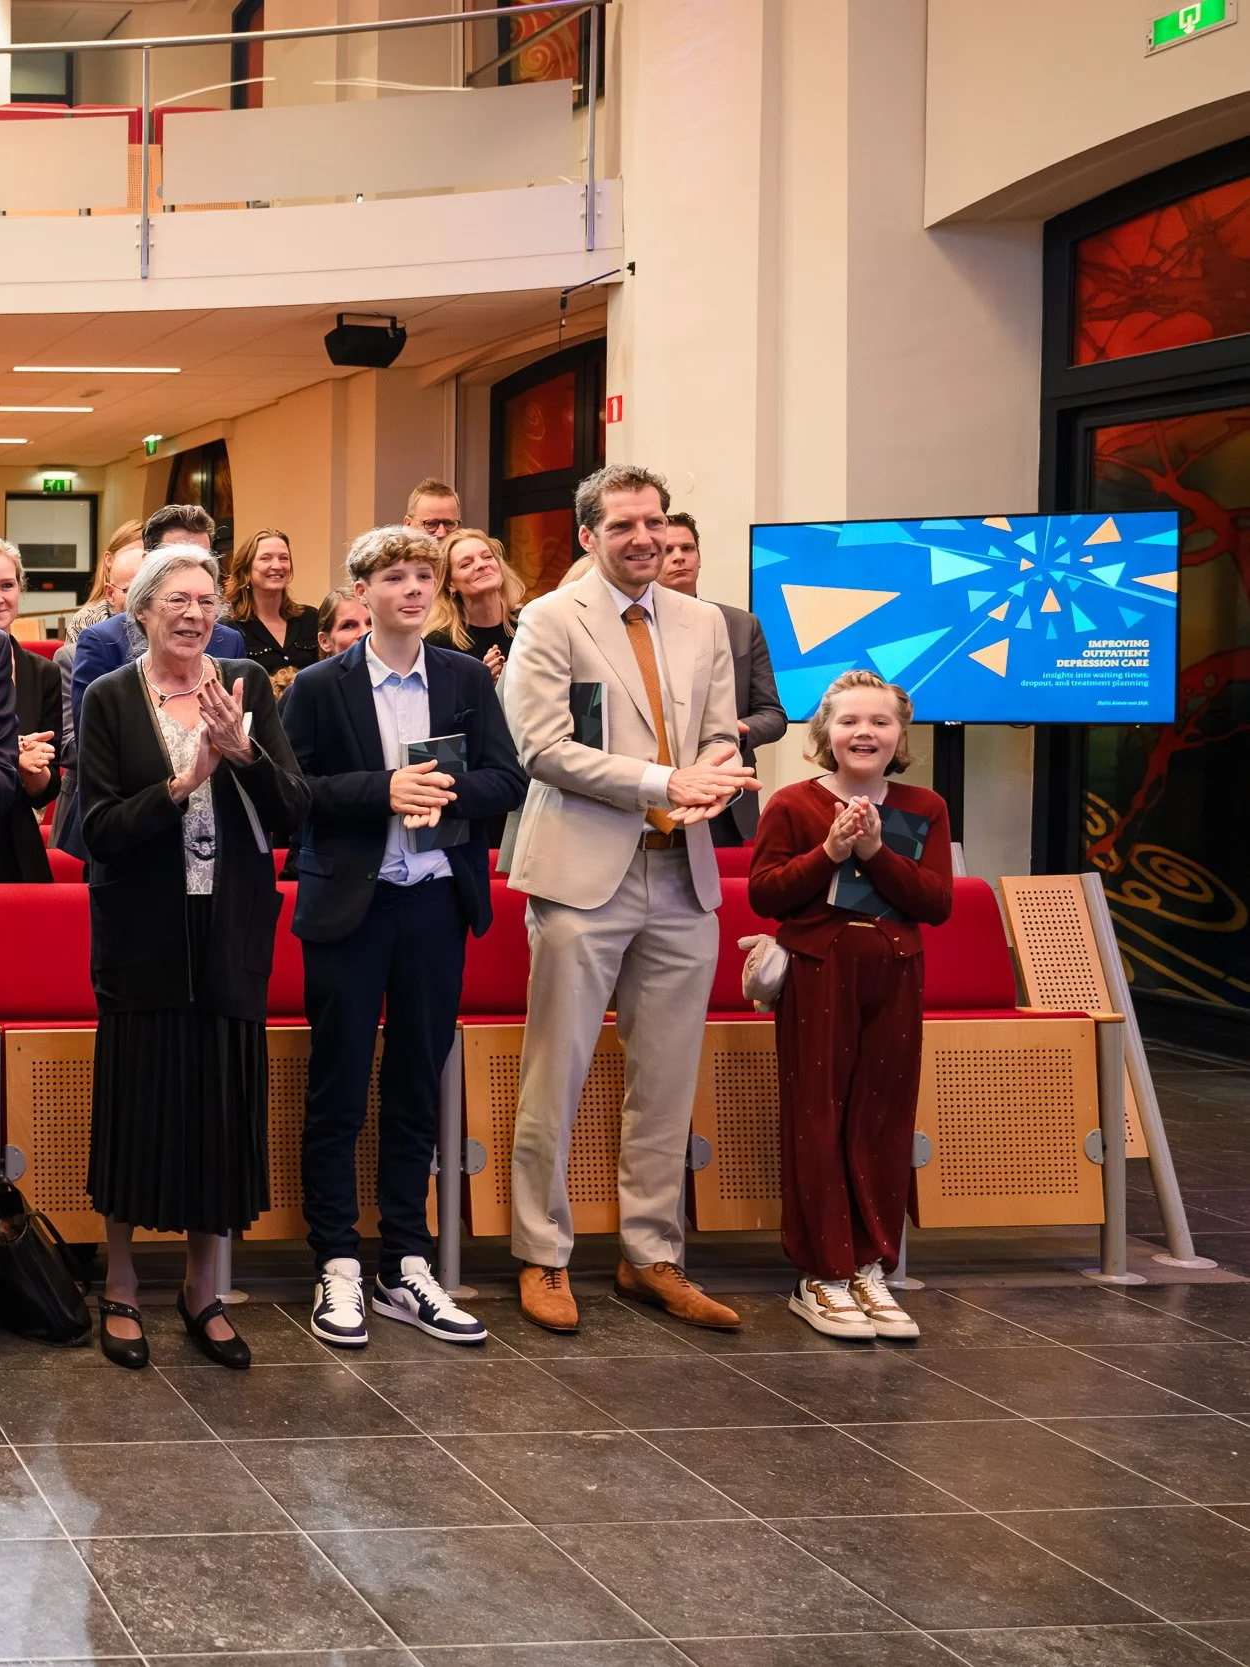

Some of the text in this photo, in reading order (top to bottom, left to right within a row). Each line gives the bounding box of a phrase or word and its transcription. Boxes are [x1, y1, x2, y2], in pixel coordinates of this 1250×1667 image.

[1088, 639, 1150, 648] IMPROVING
[1082, 649, 1150, 658] OUTPATIENT
[1056, 659, 1150, 668] DEPRESSION CARE
[1042, 671, 1074, 679] insights
[1075, 671, 1091, 679] into
[1093, 671, 1123, 680] waiting
[1020, 680, 1053, 688] dropout,
[1054, 679, 1070, 687] and
[1112, 679, 1149, 688] planning
